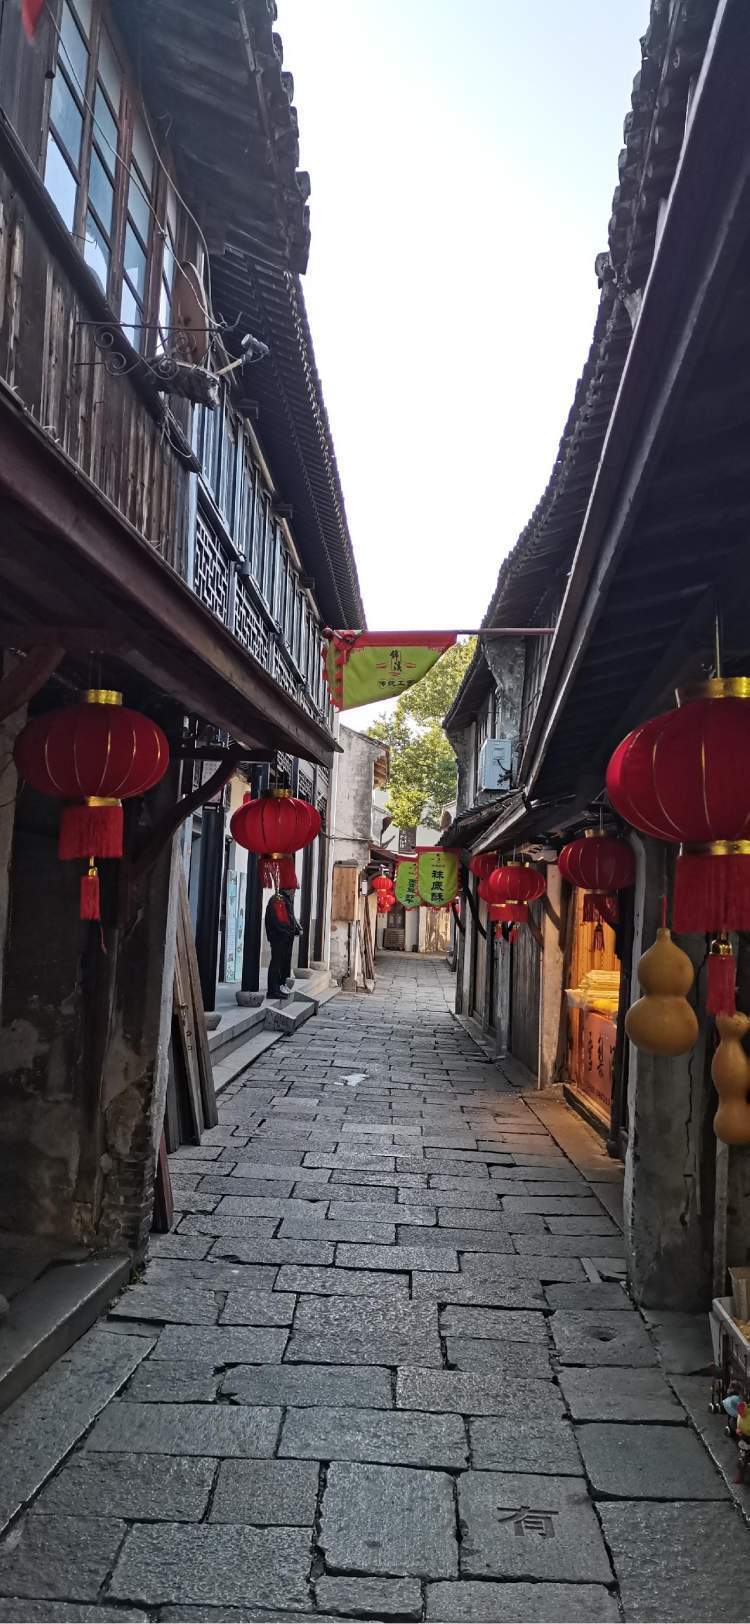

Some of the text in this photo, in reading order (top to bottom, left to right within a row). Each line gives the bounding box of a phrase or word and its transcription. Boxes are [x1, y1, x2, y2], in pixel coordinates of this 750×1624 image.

[431, 870, 444, 902] 袜底酥
[496, 1505, 559, 1539] 有
